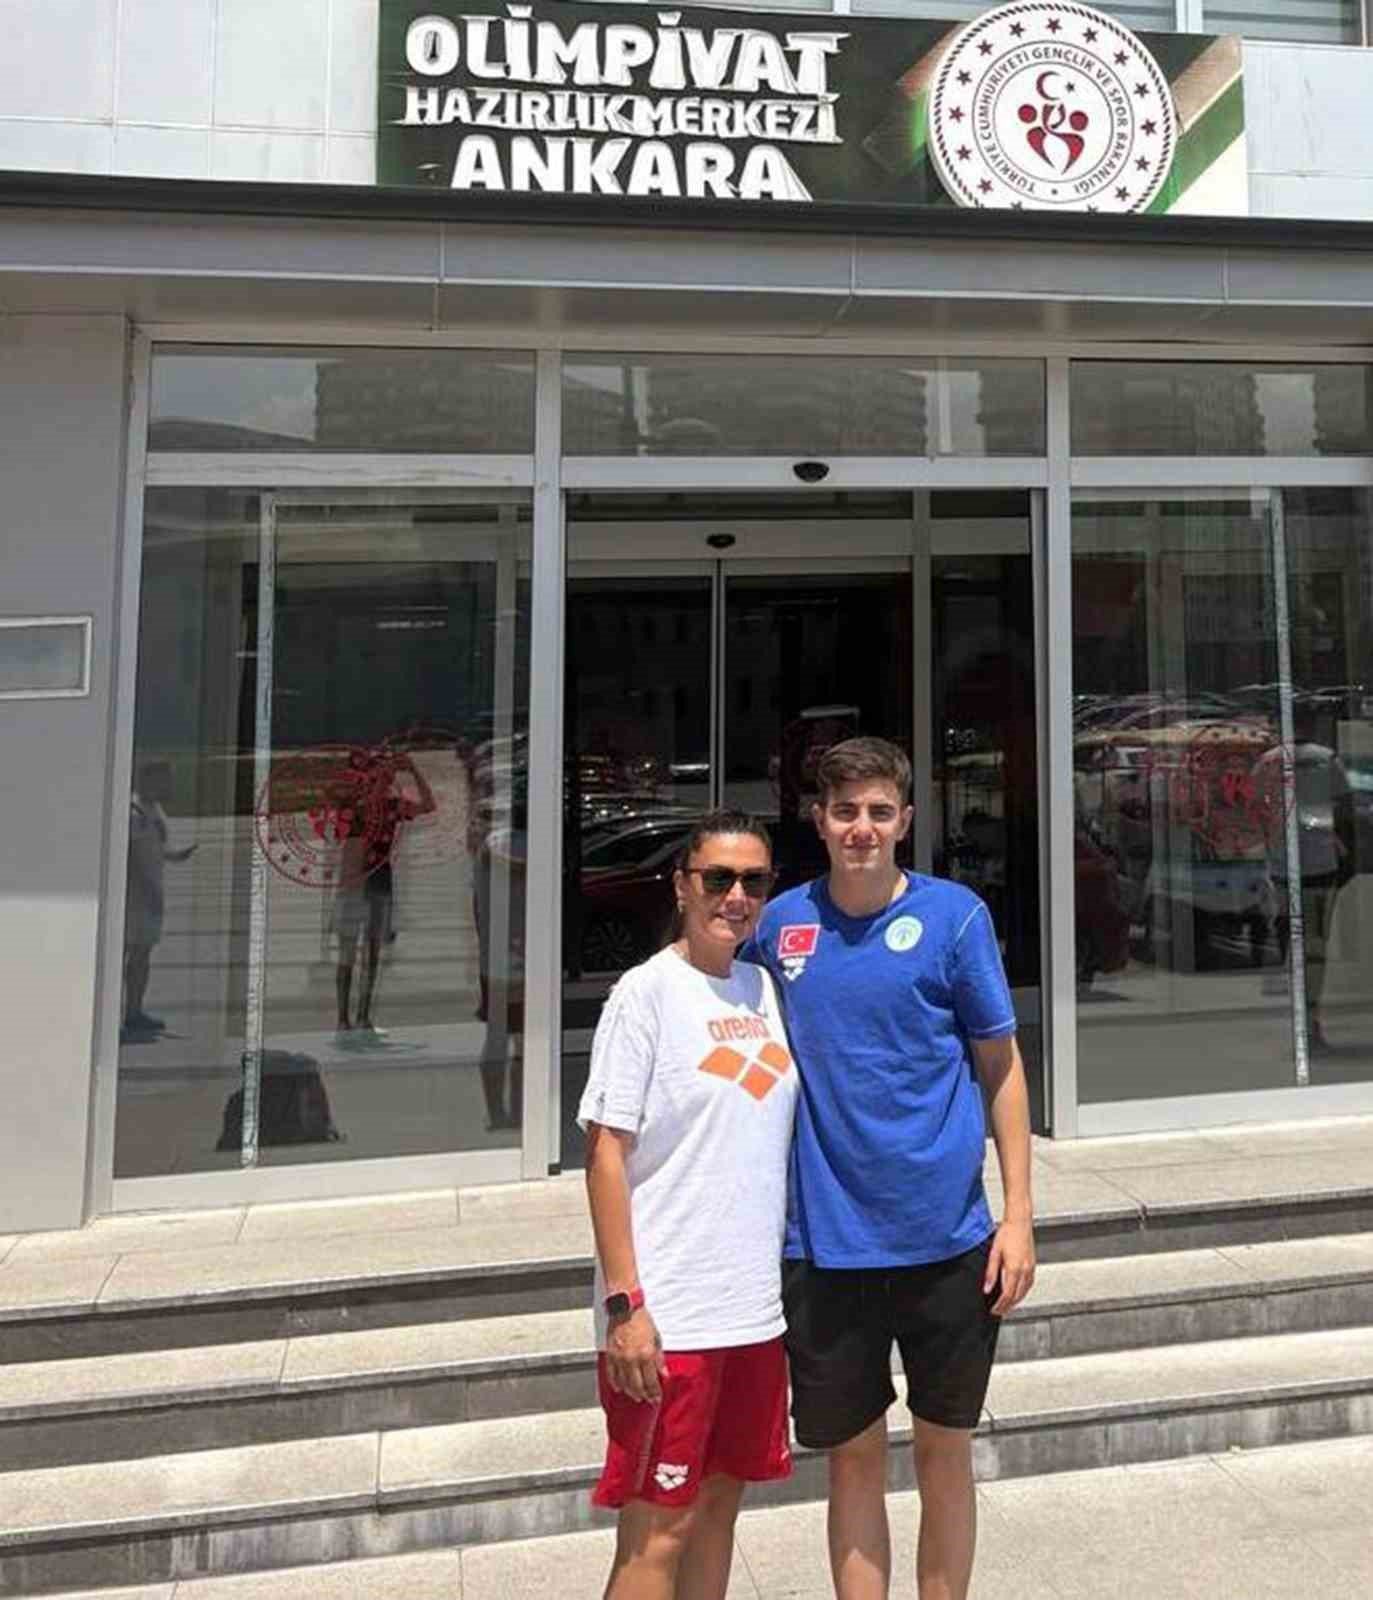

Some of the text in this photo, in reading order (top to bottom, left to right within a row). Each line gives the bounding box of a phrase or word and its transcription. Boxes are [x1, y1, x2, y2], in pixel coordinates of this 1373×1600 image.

[1031, 46, 1096, 72] GENÇLİK
[1095, 68, 1113, 87] VE
[398, 86, 845, 143] HAZIRLIK MERKEZİ
[978, 49, 1030, 141] CUMHURİYETİ
[1107, 87, 1129, 128] SPOR
[450, 134, 814, 201] ANKARA
[1073, 131, 1129, 194] BAKANLIĞI
